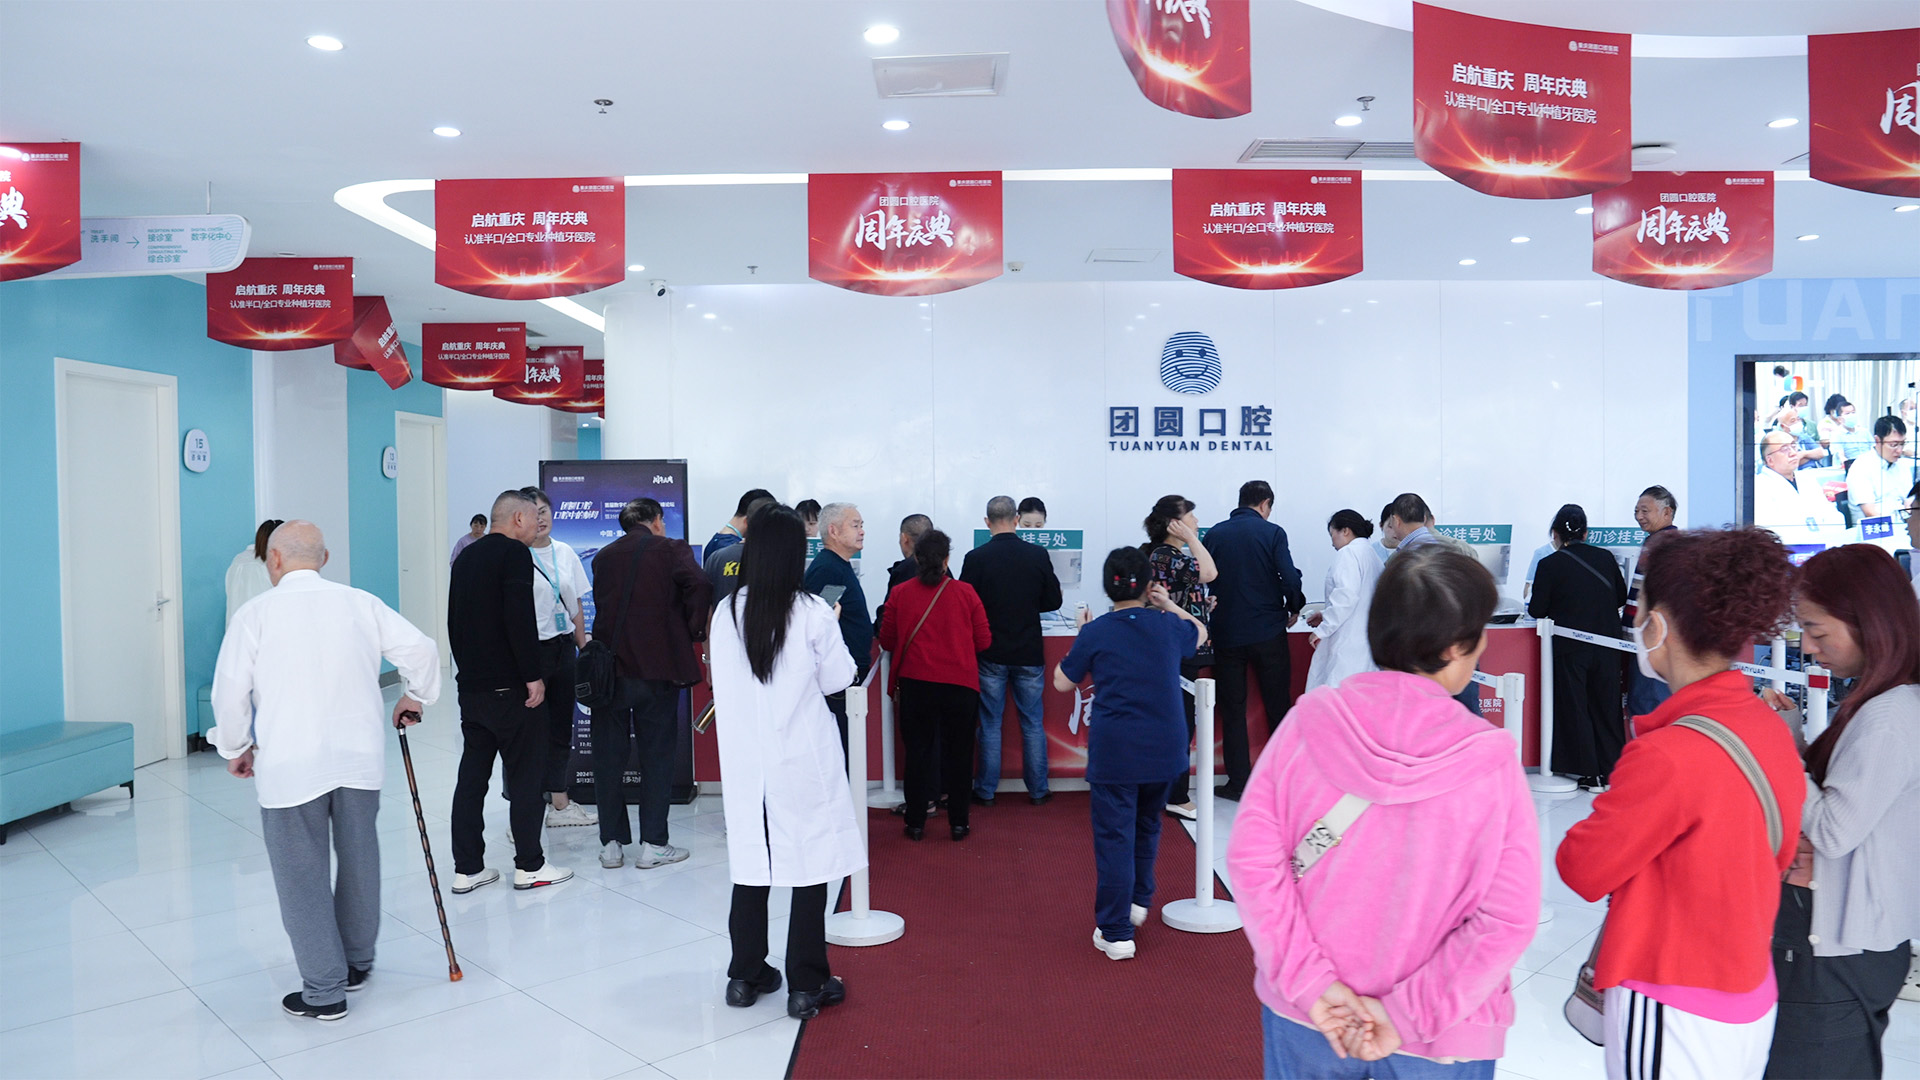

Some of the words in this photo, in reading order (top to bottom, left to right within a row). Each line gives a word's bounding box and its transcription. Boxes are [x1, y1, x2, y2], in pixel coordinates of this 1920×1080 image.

[1452, 62, 1515, 91] 启航重庆
[1523, 72, 1588, 98] 周年庆典
[1444, 90, 1597, 124] 认准半口/全口专业种植牙医院
[879, 195, 940, 206] 团圆口腔医院
[1660, 193, 1717, 202] 团圆口腔医院
[1210, 202, 1266, 217] 启航重庆
[1273, 201, 1327, 216] 周年庆典
[471, 213, 526, 227] 启航重庆
[532, 211, 588, 226] 周年庆典
[1636, 205, 1731, 245] 周年庆典
[855, 209, 955, 250] 周年庆典
[1202, 222, 1334, 234] 认准半口/全口专业种植牙医院
[91, 234, 119, 243] 洗手间
[191, 232, 232, 240] 数字化中心
[464, 231, 596, 245] 认准半口/全口专业种植牙医院
[235, 284, 277, 296] 启航重庆
[282, 284, 326, 296] 周年庆典
[230, 300, 331, 309] 认准半口/全口专业种植牙医院
[442, 342, 471, 350] 启航重庆
[475, 342, 506, 350] 周年庆典
[1109, 405, 1272, 437] 团圆口腔
[195, 438, 204, 448] 15
[1109, 440, 1200, 451] TUANYUAN
[1208, 440, 1273, 450] DENTAL
[1588, 530, 1650, 544] 初诊挂号
